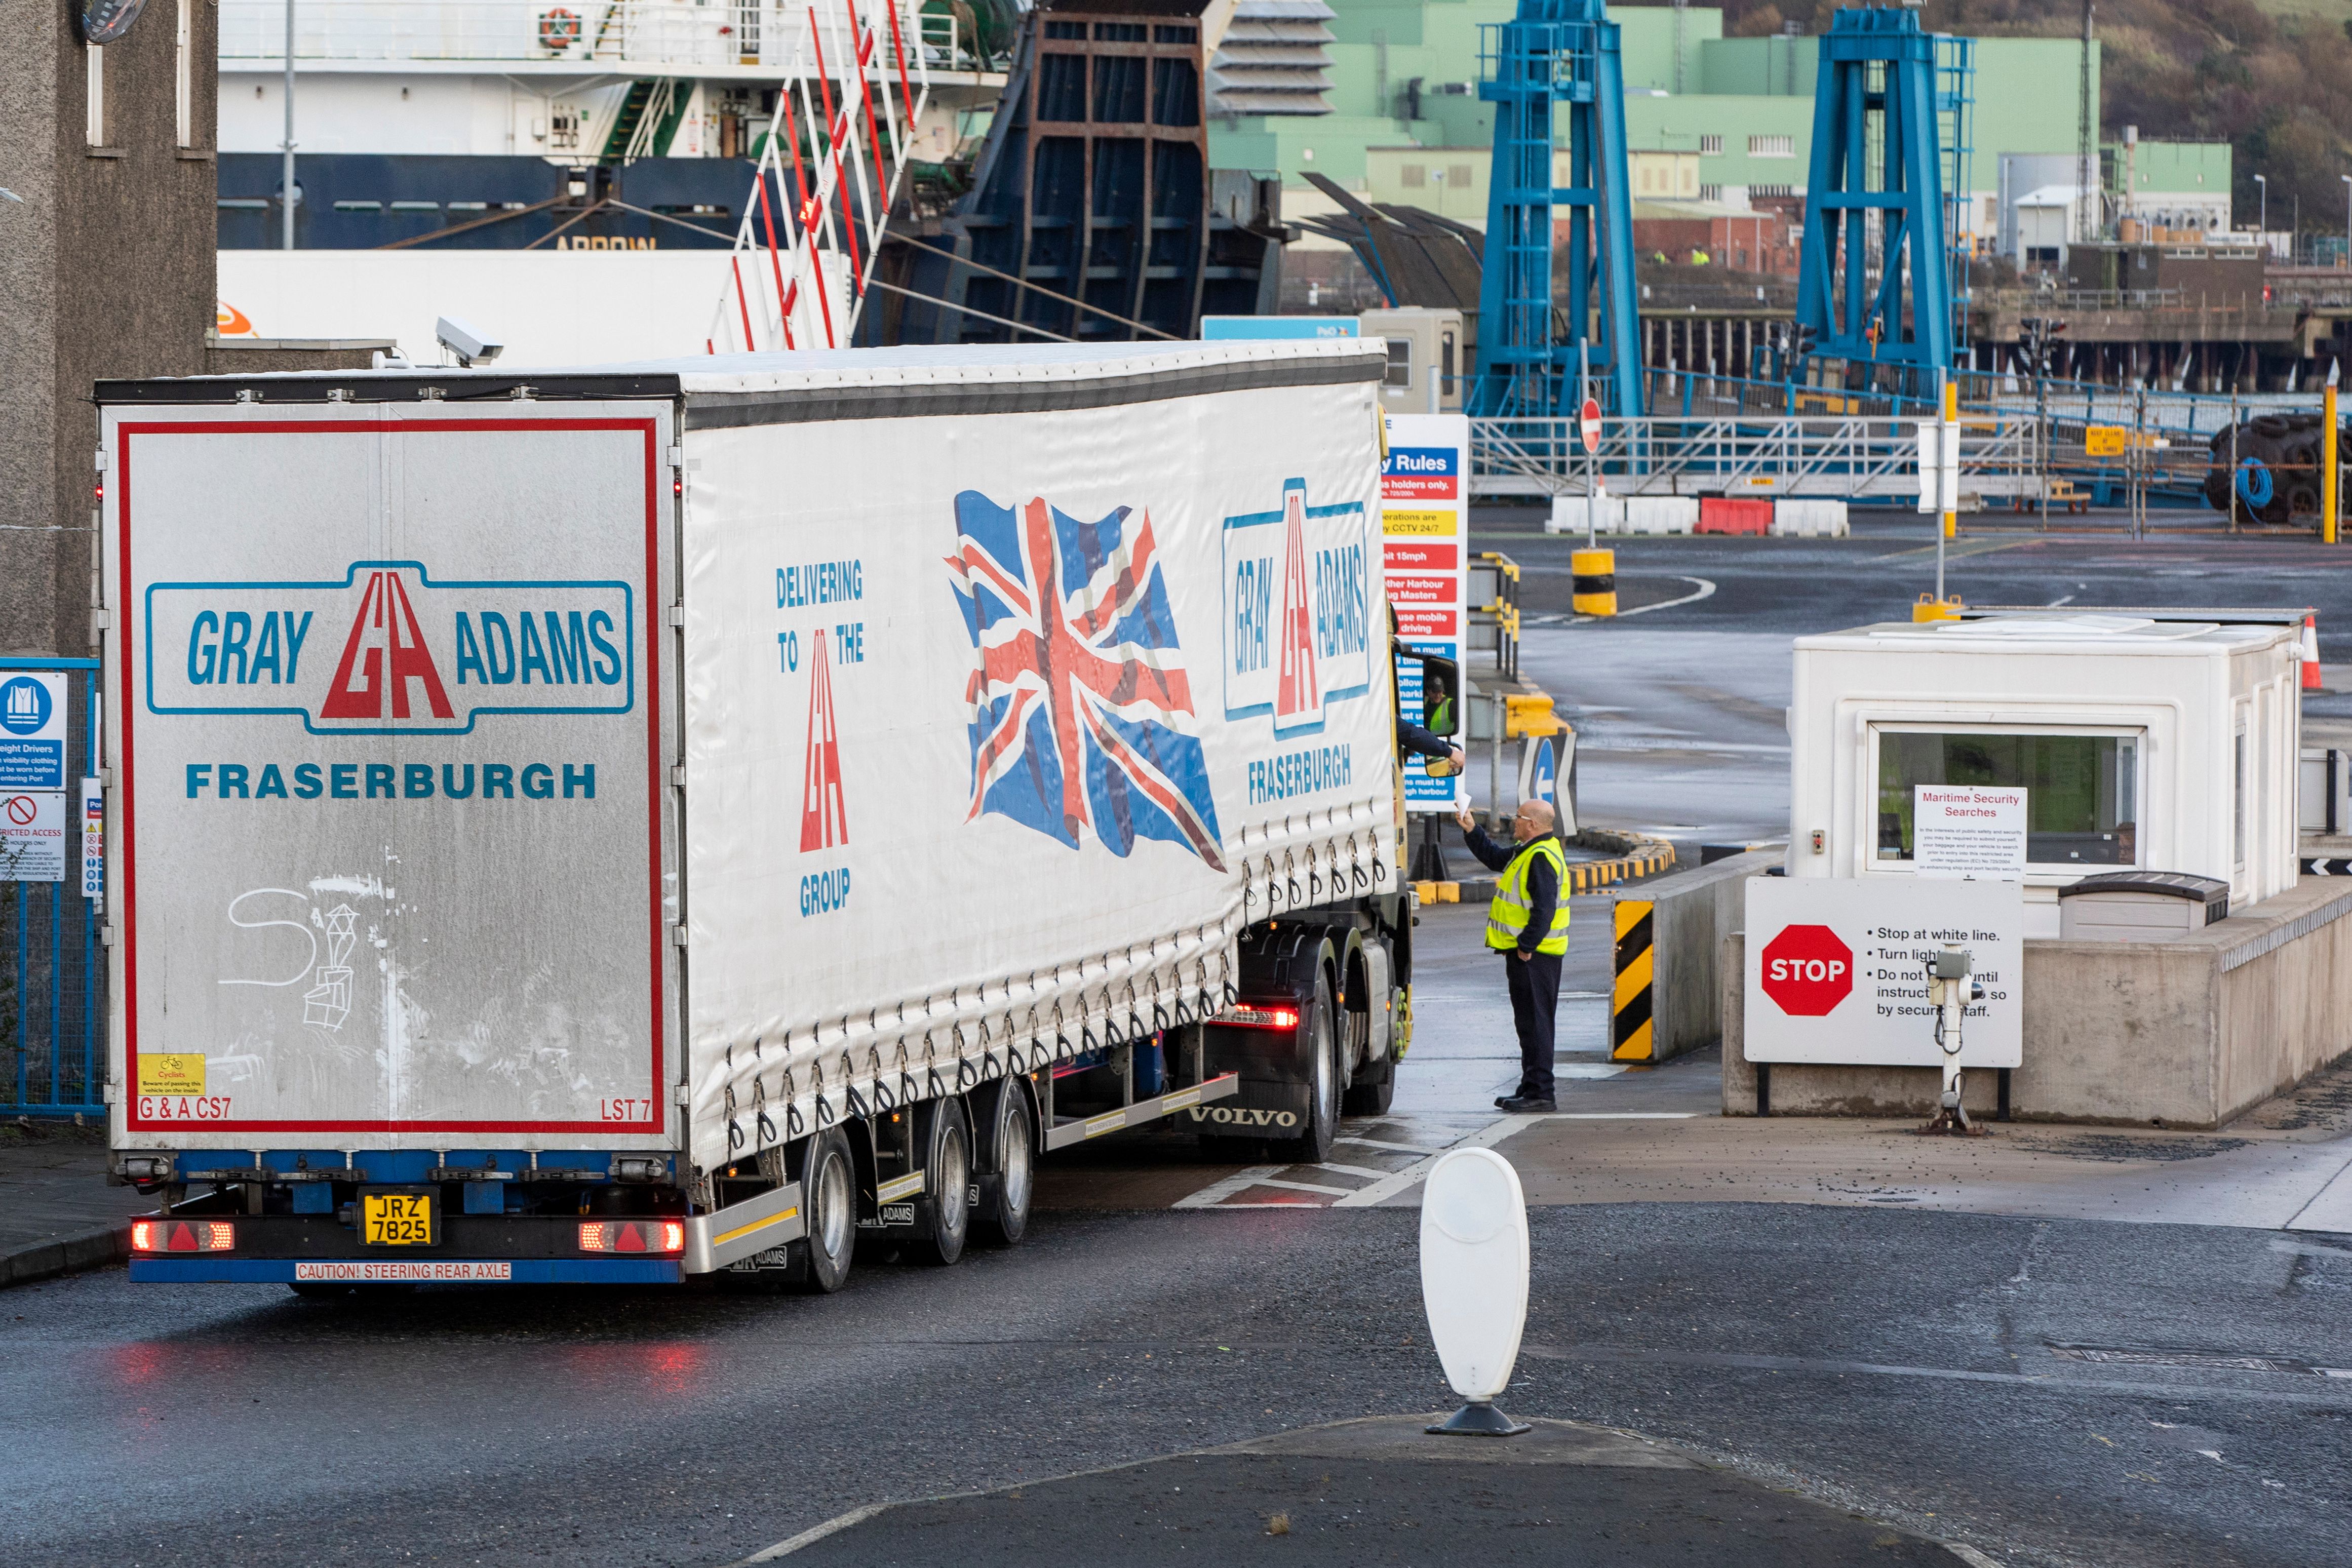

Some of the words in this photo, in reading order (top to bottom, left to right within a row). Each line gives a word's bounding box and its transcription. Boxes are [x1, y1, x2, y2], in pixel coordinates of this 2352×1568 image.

[1396, 454, 1447, 471] Rules
[1391, 480, 1426, 489] holders
[1427, 480, 1449, 491] only.
[1397, 552, 1427, 562] 15mph
[776, 559, 862, 609] DELIVERING
[1385, 579, 1405, 588] ther
[1407, 579, 1444, 589] Harbour
[1400, 591, 1437, 600] Masters
[1235, 557, 1273, 676] GRAY
[1317, 543, 1365, 660] ADAMS
[1417, 613, 1447, 621] mobile
[1401, 624, 1432, 634] driving
[187, 610, 313, 685] GRAY
[456, 609, 622, 686] ADAMS
[778, 630, 798, 673] TO
[836, 622, 864, 664] THE
[23, 744, 53, 753] Drivers
[3, 757, 29, 765] visibility
[185, 762, 596, 799] FRASERBURGH
[1249, 743, 1351, 805] FRASERBURGH
[1923, 793, 1970, 803] Maritime
[1974, 794, 2019, 806] Security
[1945, 807, 1996, 817] Searches
[800, 868, 850, 918] GROUP
[1877, 927, 1909, 943] Stop
[1914, 929, 1927, 939] at
[1931, 929, 1968, 940] white
[1973, 930, 2000, 941] line.
[1877, 949, 1907, 960] Turn
[1912, 949, 1940, 963] ligh
[1769, 958, 1845, 982] STOP
[1877, 969, 1896, 981] Do
[1901, 969, 1923, 981] not
[1990, 991, 2006, 1000] so
[1877, 1004, 1892, 1017] by
[1960, 1006, 1990, 1017] taff.
[140, 1096, 152, 1119] G
[160, 1096, 172, 1118] &
[178, 1096, 191, 1118] A
[197, 1096, 231, 1119] CS7
[602, 1099, 635, 1121] LST
[641, 1099, 651, 1120] 7
[1189, 1106, 1297, 1127] VOLVO
[376, 1198, 420, 1218] JRZ
[883, 1207, 912, 1221] ADAMS
[372, 1220, 426, 1240] 7825
[756, 1250, 785, 1265] ADAMS
[298, 1264, 360, 1279] CAUTION!
[365, 1264, 430, 1279] STEERING
[436, 1264, 470, 1279] REAR
[477, 1263, 509, 1279] AXLE
